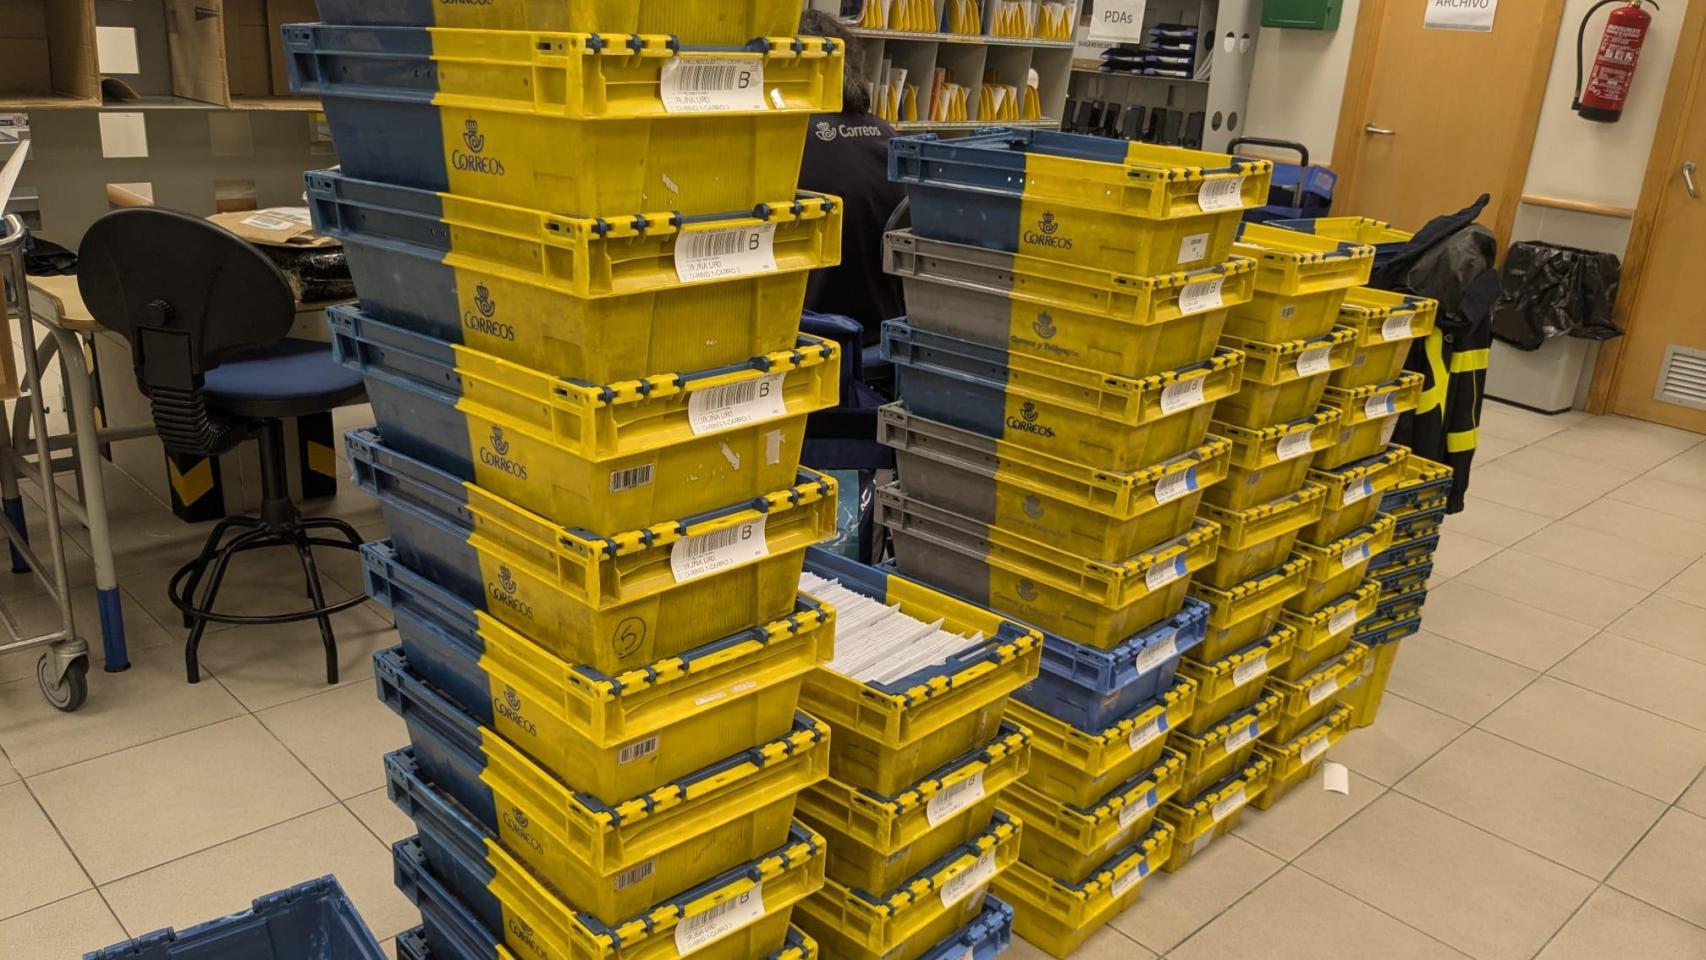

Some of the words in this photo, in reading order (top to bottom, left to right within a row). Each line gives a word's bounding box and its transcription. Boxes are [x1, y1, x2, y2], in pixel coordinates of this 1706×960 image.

[1104, 10, 1133, 24] PDAs
[738, 71, 751, 89] B
[838, 124, 882, 138] Correos
[452, 149, 505, 176] CORREOS
[749, 233, 760, 250] B
[1023, 230, 1073, 249] CORREOS
[464, 311, 515, 341] CORREOS
[759, 382, 770, 397] B
[1006, 416, 1052, 437] CORREOS
[480, 446, 528, 480] CORREOS
[741, 525, 752, 540] B
[488, 581, 534, 620] CORREOS
[494, 697, 537, 737] CORREOS
